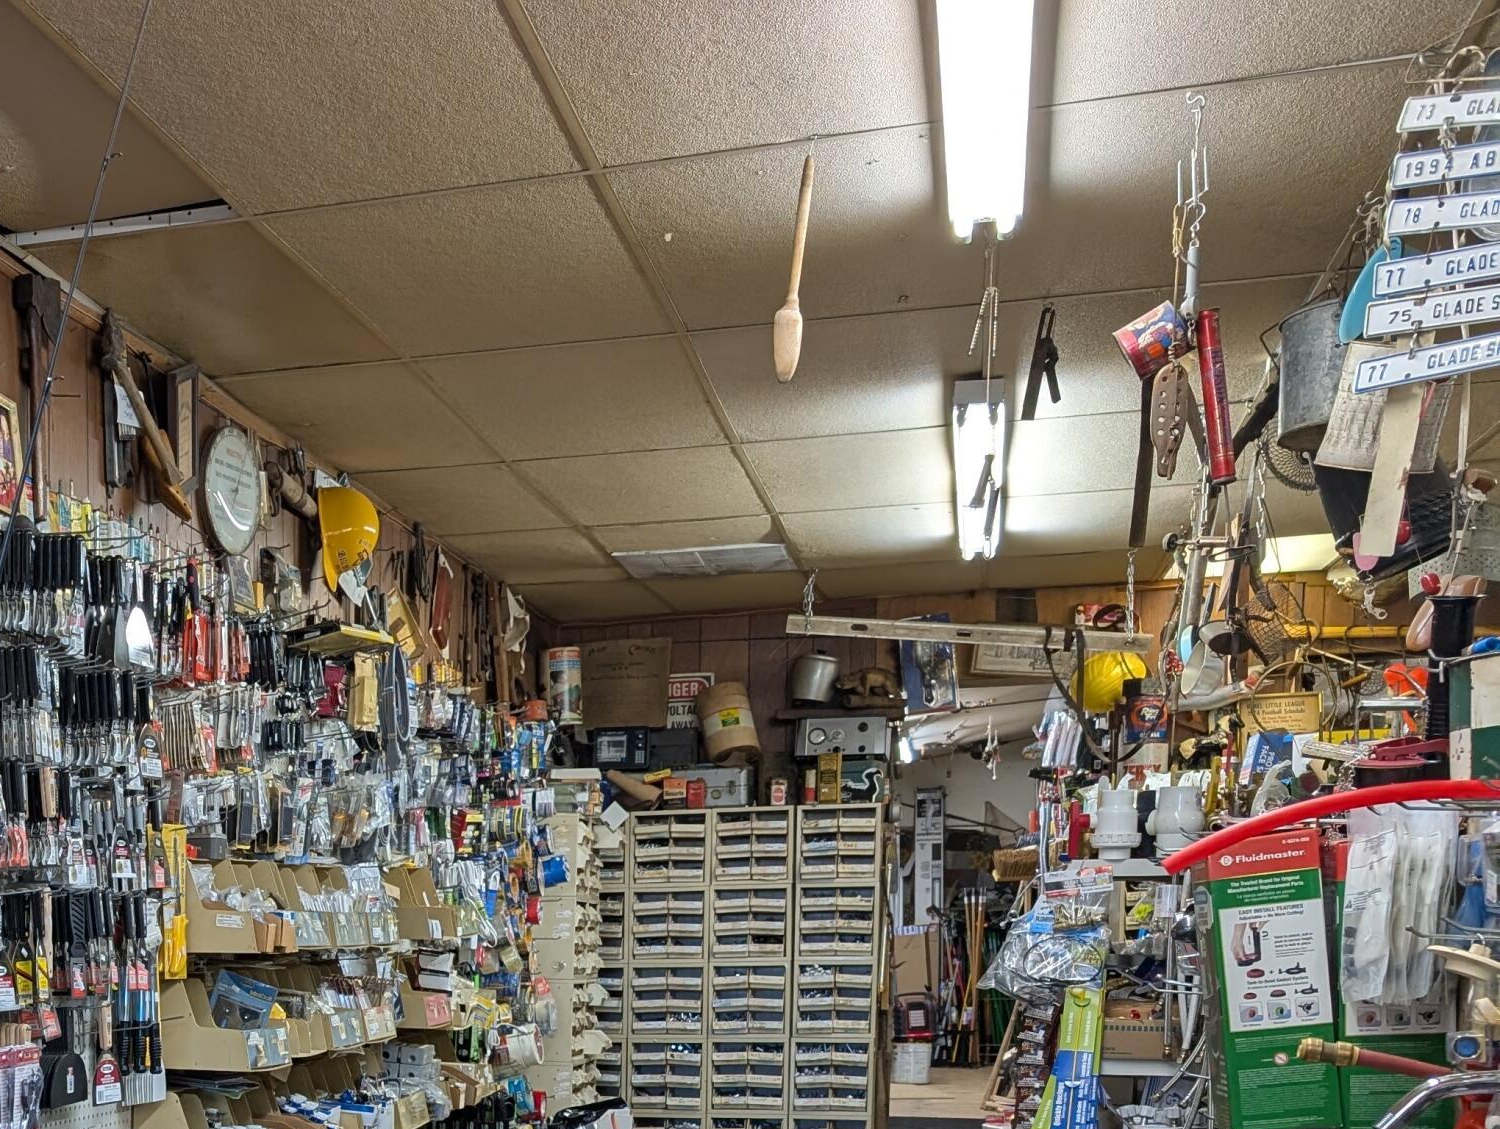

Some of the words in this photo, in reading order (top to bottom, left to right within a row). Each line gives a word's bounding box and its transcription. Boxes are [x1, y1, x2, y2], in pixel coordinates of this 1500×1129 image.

[1416, 103, 1437, 121] 73
[1406, 157, 1453, 178] 1994
[1404, 207, 1422, 224] 78
[1386, 267, 1406, 288] 77
[1445, 252, 1499, 276] GLADE
[1388, 309, 1412, 324] 75
[1433, 297, 1486, 319] GLADE
[1368, 363, 1388, 383] 77
[1427, 343, 1479, 370] GLADE
[669, 682, 698, 697] GER
[1235, 848, 1304, 864] Fluidmaster
